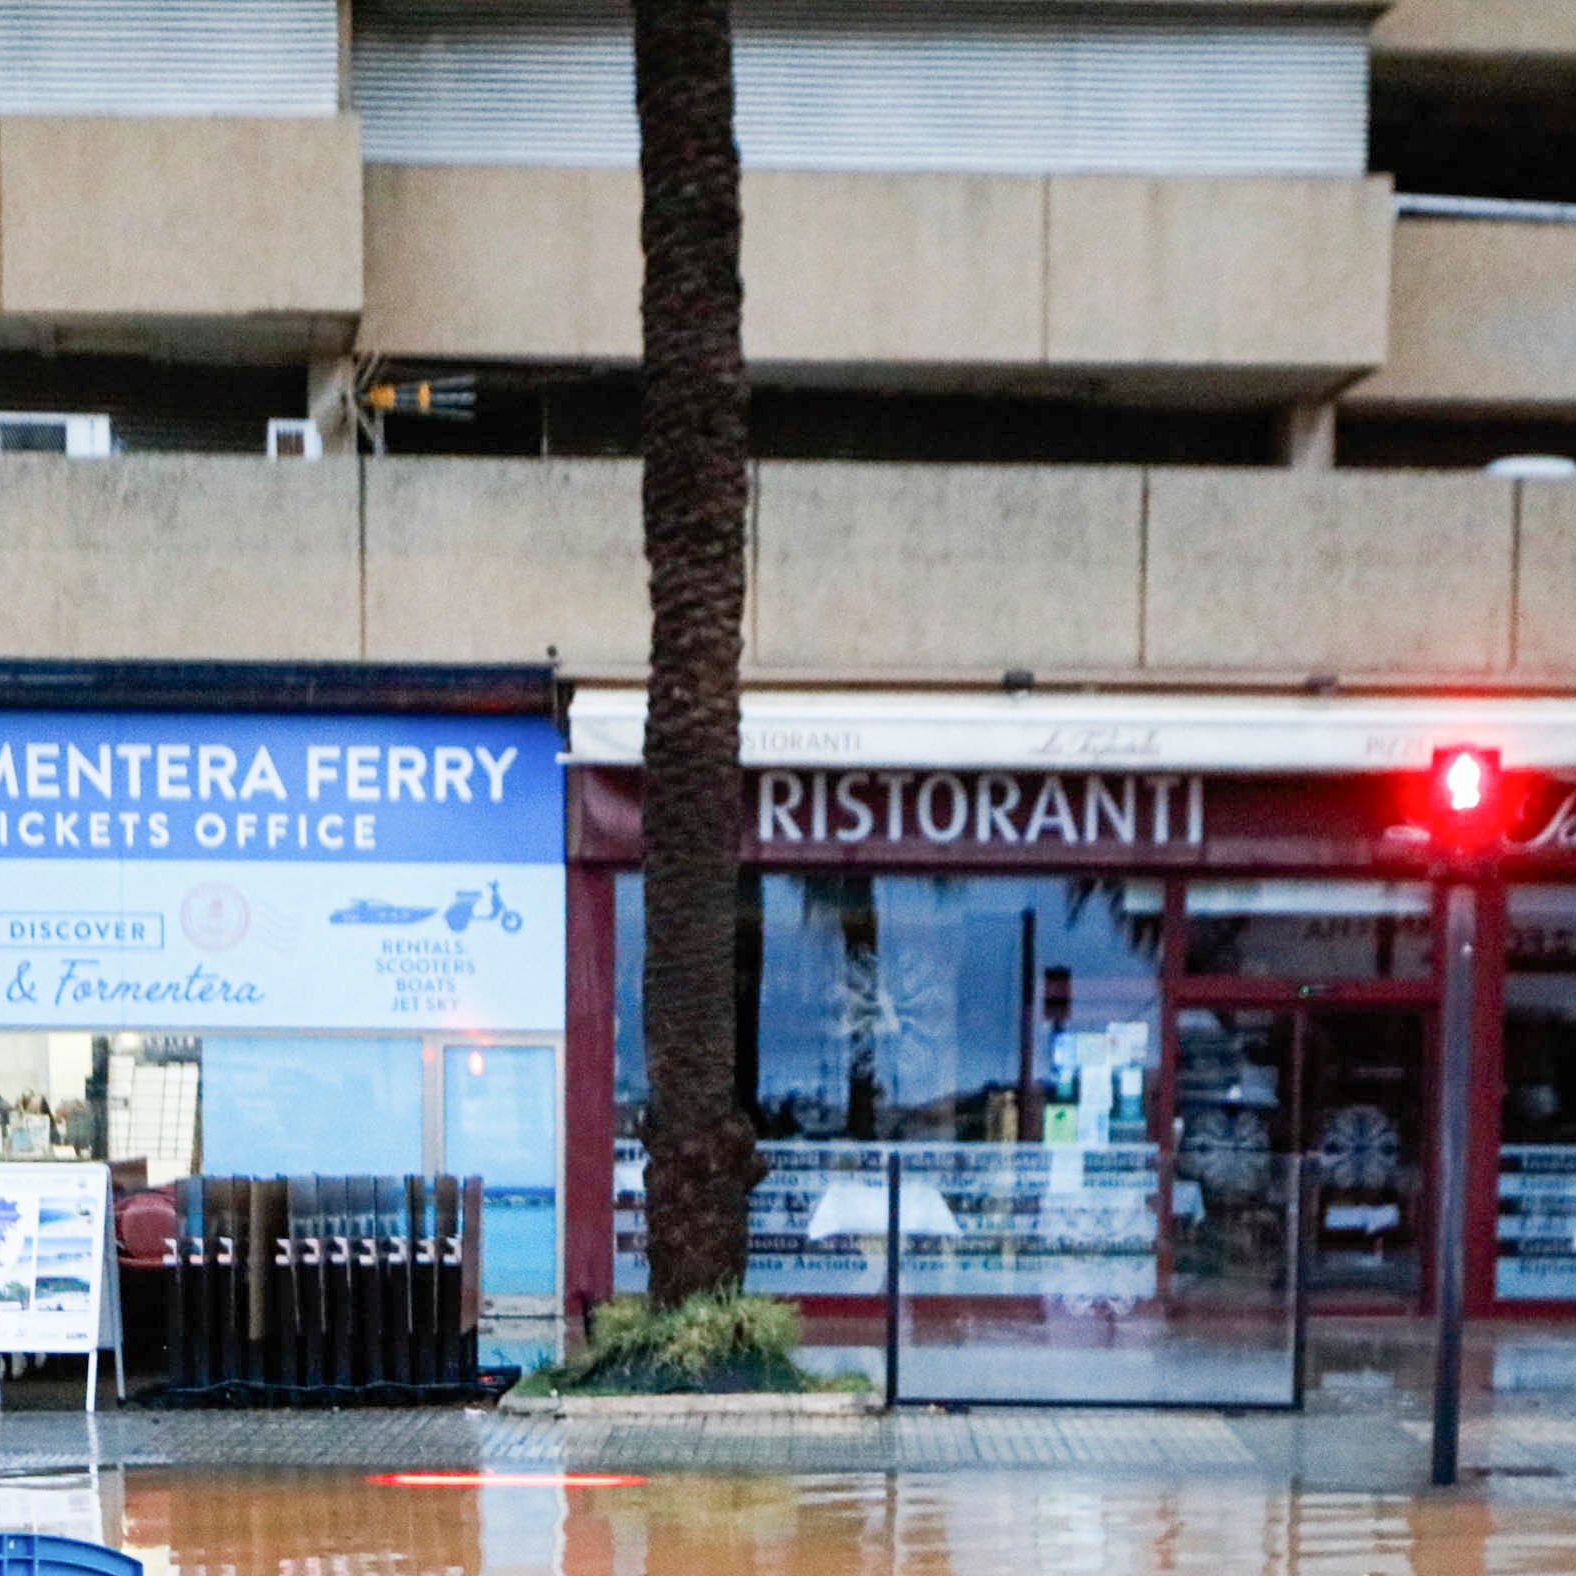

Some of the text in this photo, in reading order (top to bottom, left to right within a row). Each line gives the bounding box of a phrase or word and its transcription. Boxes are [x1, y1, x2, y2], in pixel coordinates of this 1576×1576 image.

[306, 744, 518, 803] FERRY
[757, 772, 1205, 844] RISTORANTI
[194, 812, 377, 850] OFFICE
[9, 919, 146, 941] DISCOVER
[375, 957, 477, 975] SCOOTERS
[5, 960, 38, 1003] &
[54, 957, 267, 1006] Formentera
[395, 977, 457, 993] BOATS
[391, 996, 420, 1012] JET
